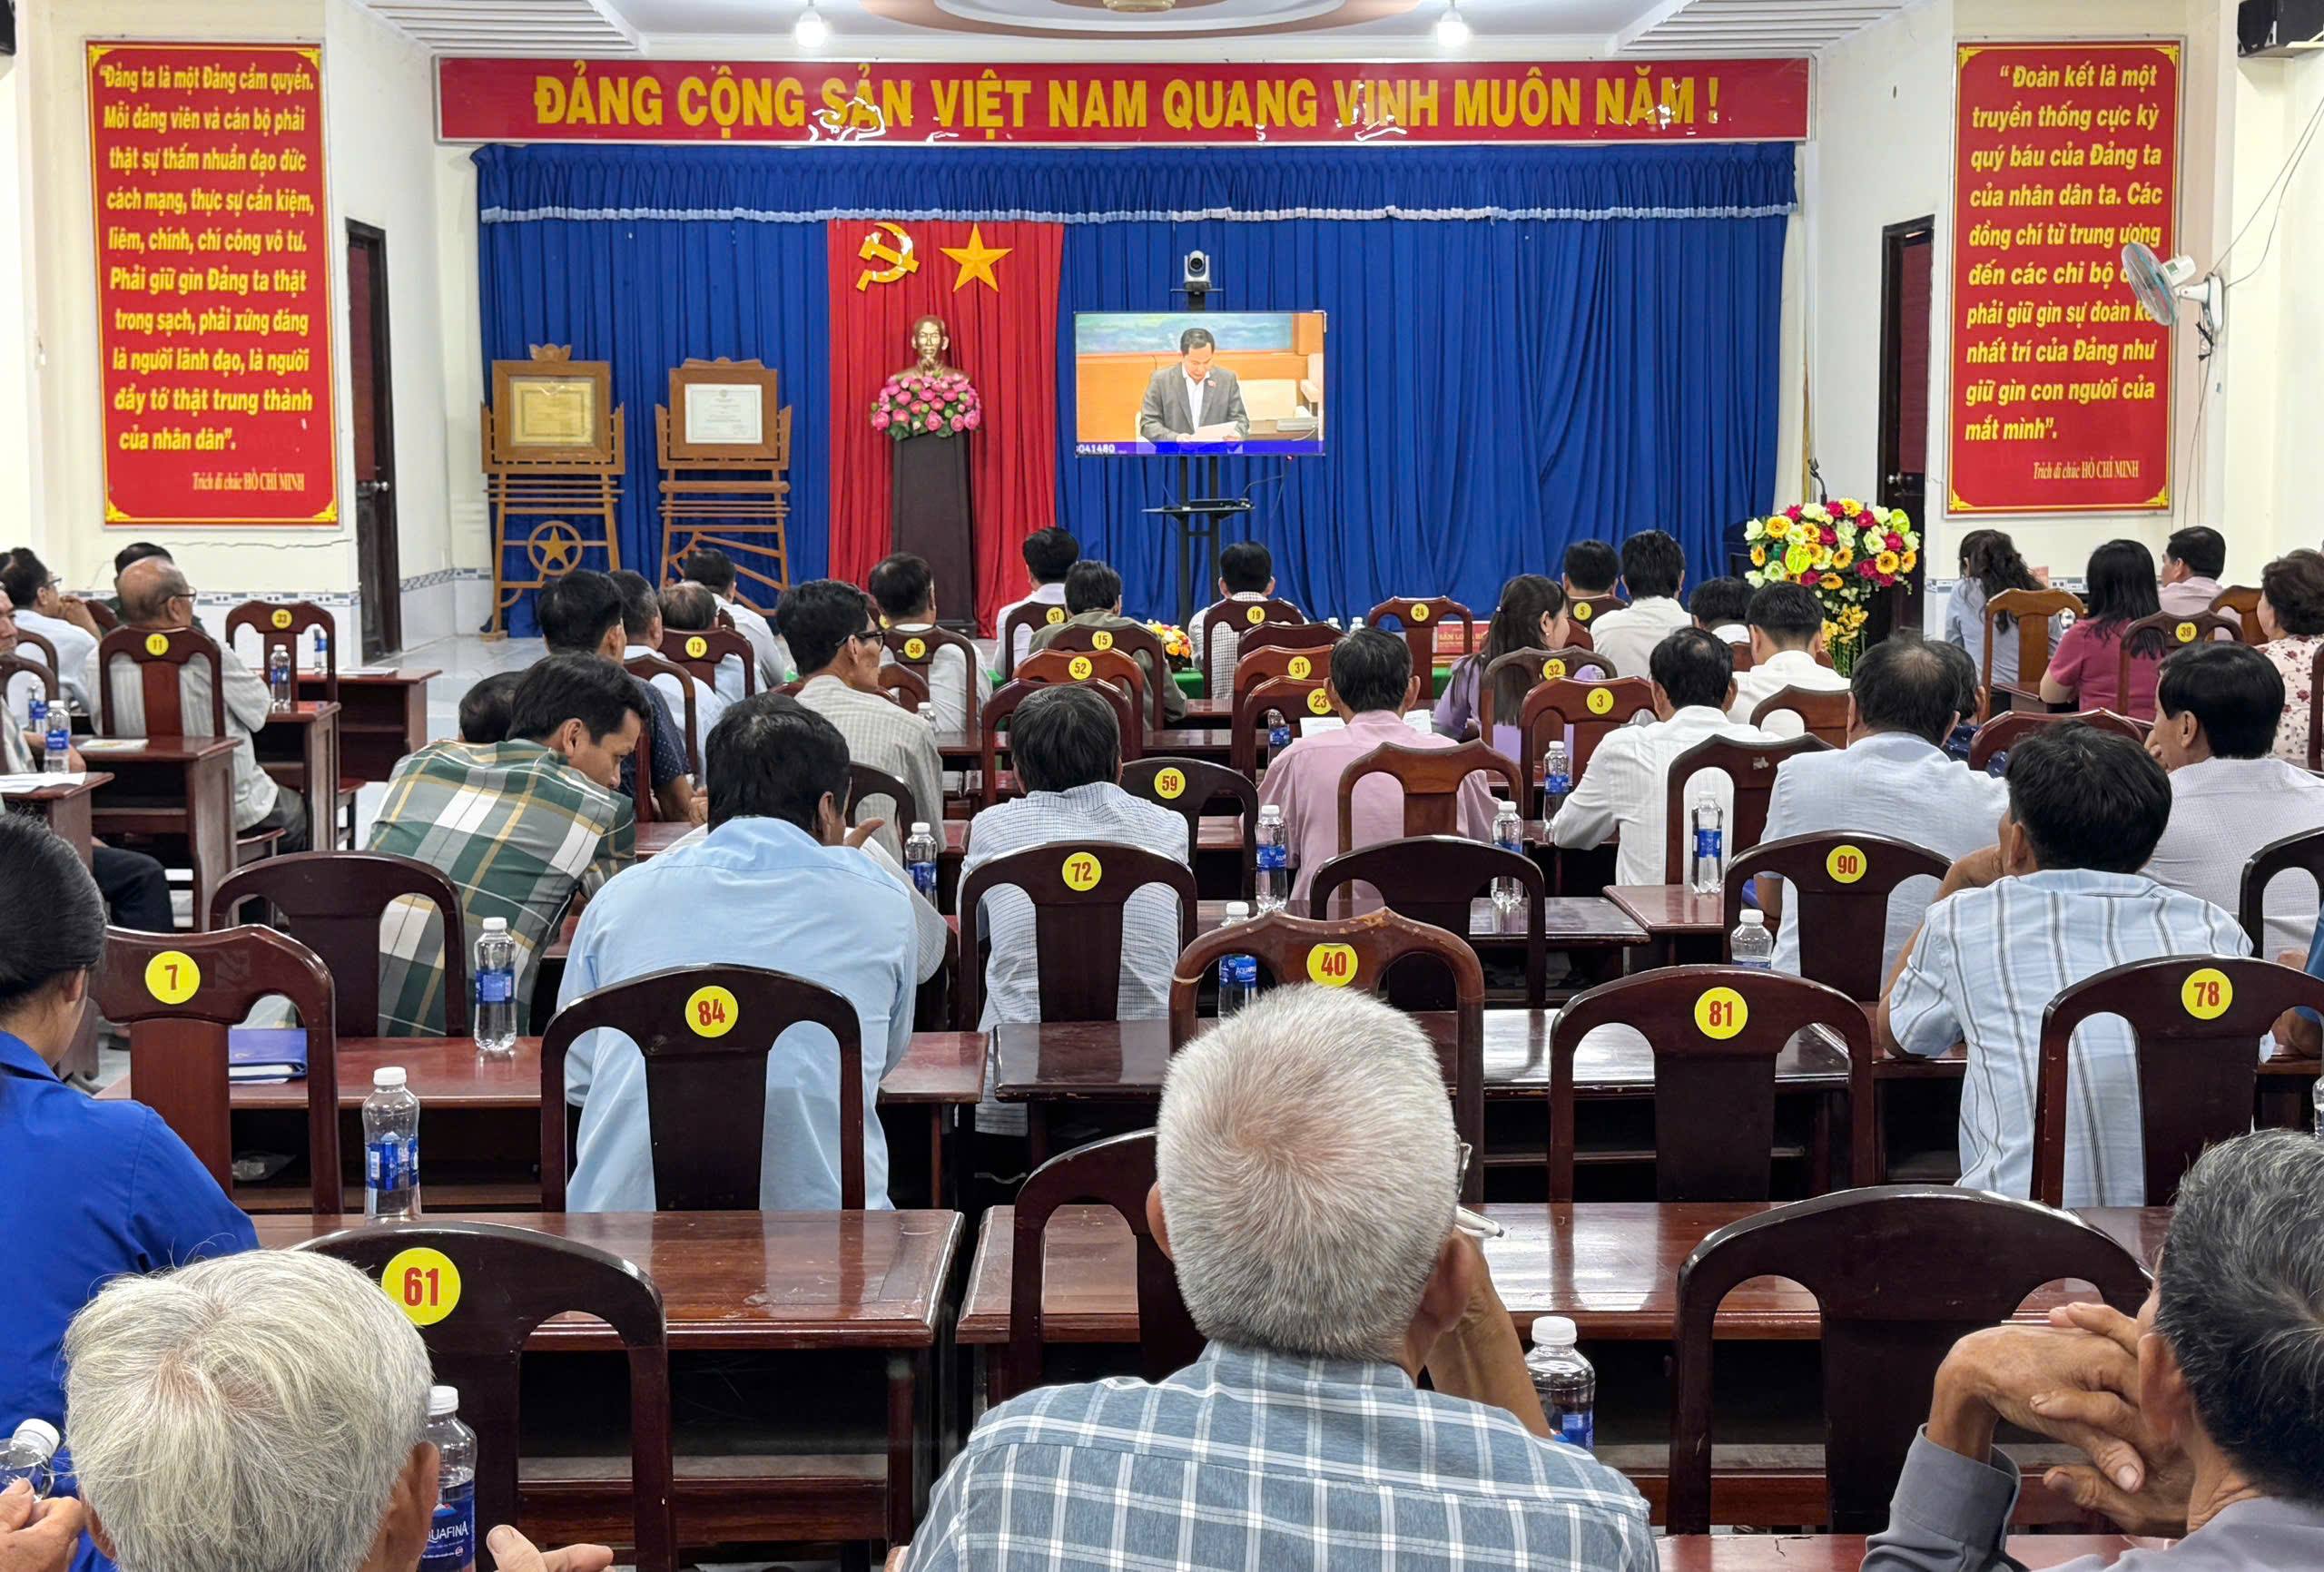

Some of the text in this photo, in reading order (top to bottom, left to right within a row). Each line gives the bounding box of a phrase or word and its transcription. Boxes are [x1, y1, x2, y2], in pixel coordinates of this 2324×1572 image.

[142, 66, 155, 88] ta
[159, 65, 171, 88] là
[173, 66, 200, 94] một
[202, 64, 236, 94] Đảng
[2013, 65, 2059, 87] Đoàn
[2064, 61, 2094, 87] kết
[2100, 64, 2116, 86] là
[2122, 64, 2157, 93] một
[535, 61, 1718, 140] ĐẢNG CỘNG SẢN VIỆT NAM QUANG VINH MUÔN NĂM !
[171, 106, 200, 129] viên
[203, 106, 220, 130] và
[223, 107, 250, 130] cán
[253, 107, 271, 136] bộ
[274, 105, 305, 135] phải
[1973, 101, 2159, 133] truyền thống cực kỳ
[110, 146, 139, 175] thật
[142, 148, 160, 175] sự
[162, 142, 200, 170] thấm
[250, 148, 276, 177] đạo
[280, 148, 306, 172] đức
[1971, 141, 2162, 172] quý báu của Đảng ta
[107, 187, 142, 210] cách
[144, 192, 187, 216] mạng,
[191, 188, 222, 217] thực
[225, 190, 244, 217] sự
[275, 189, 314, 218] kiệm,
[1970, 182, 2162, 207] của nhân dân ta. Các
[109, 227, 307, 256] liêm, chính, chí công vô tư.
[1969, 220, 2162, 251] đồng chí từ trung ương
[110, 264, 307, 298] Phải giữ gìn Đảng ta thật
[1968, 259, 2005, 285] đến
[2011, 261, 2047, 285] các
[2053, 261, 2084, 284] chi
[2089, 261, 2114, 290] bộ
[115, 305, 309, 337] trong sạch, phải xứng đáng
[1966, 300, 2004, 329] phải
[2007, 301, 2034, 329] giữ
[2036, 300, 2062, 328] gìn
[2066, 302, 2087, 329] sự
[2091, 300, 2131, 322] đoàn
[113, 348, 310, 378] là người lãnh đạo, là người
[1966, 336, 2157, 365] nhất trí của Đảng như
[150, 387, 170, 410] tớ
[172, 388, 209, 417] thật
[212, 388, 259, 416] trung
[263, 388, 312, 411] thành
[1966, 379, 1995, 407] giữ
[1998, 378, 2026, 406] gìn
[2031, 384, 2063, 400] con
[2122, 374, 2155, 399] của
[119, 425, 149, 450] của
[153, 427, 192, 450] nhân
[1965, 415, 1999, 440] mắt
[1050, 612, 1059, 621] 37
[153, 639, 162, 650] 11
[692, 643, 701, 653] 13
[1098, 635, 1108, 644] 15
[1075, 663, 1086, 674] 52
[1295, 663, 1305, 673] 31
[1549, 664, 1561, 676] 32
[1314, 693, 1328, 708] 23
[1597, 694, 1603, 707] 3
[1162, 776, 1177, 791] 59
[1071, 862, 1092, 882] 72
[1837, 855, 1857, 874] 90
[1321, 952, 1346, 976] 40
[165, 965, 177, 990] 7
[2194, 981, 2220, 1007] 78
[698, 999, 725, 1026] 84
[1709, 1001, 1732, 1027] 81
[404, 1267, 438, 1306] 61
[428, 1520, 469, 1543] UAFINA
